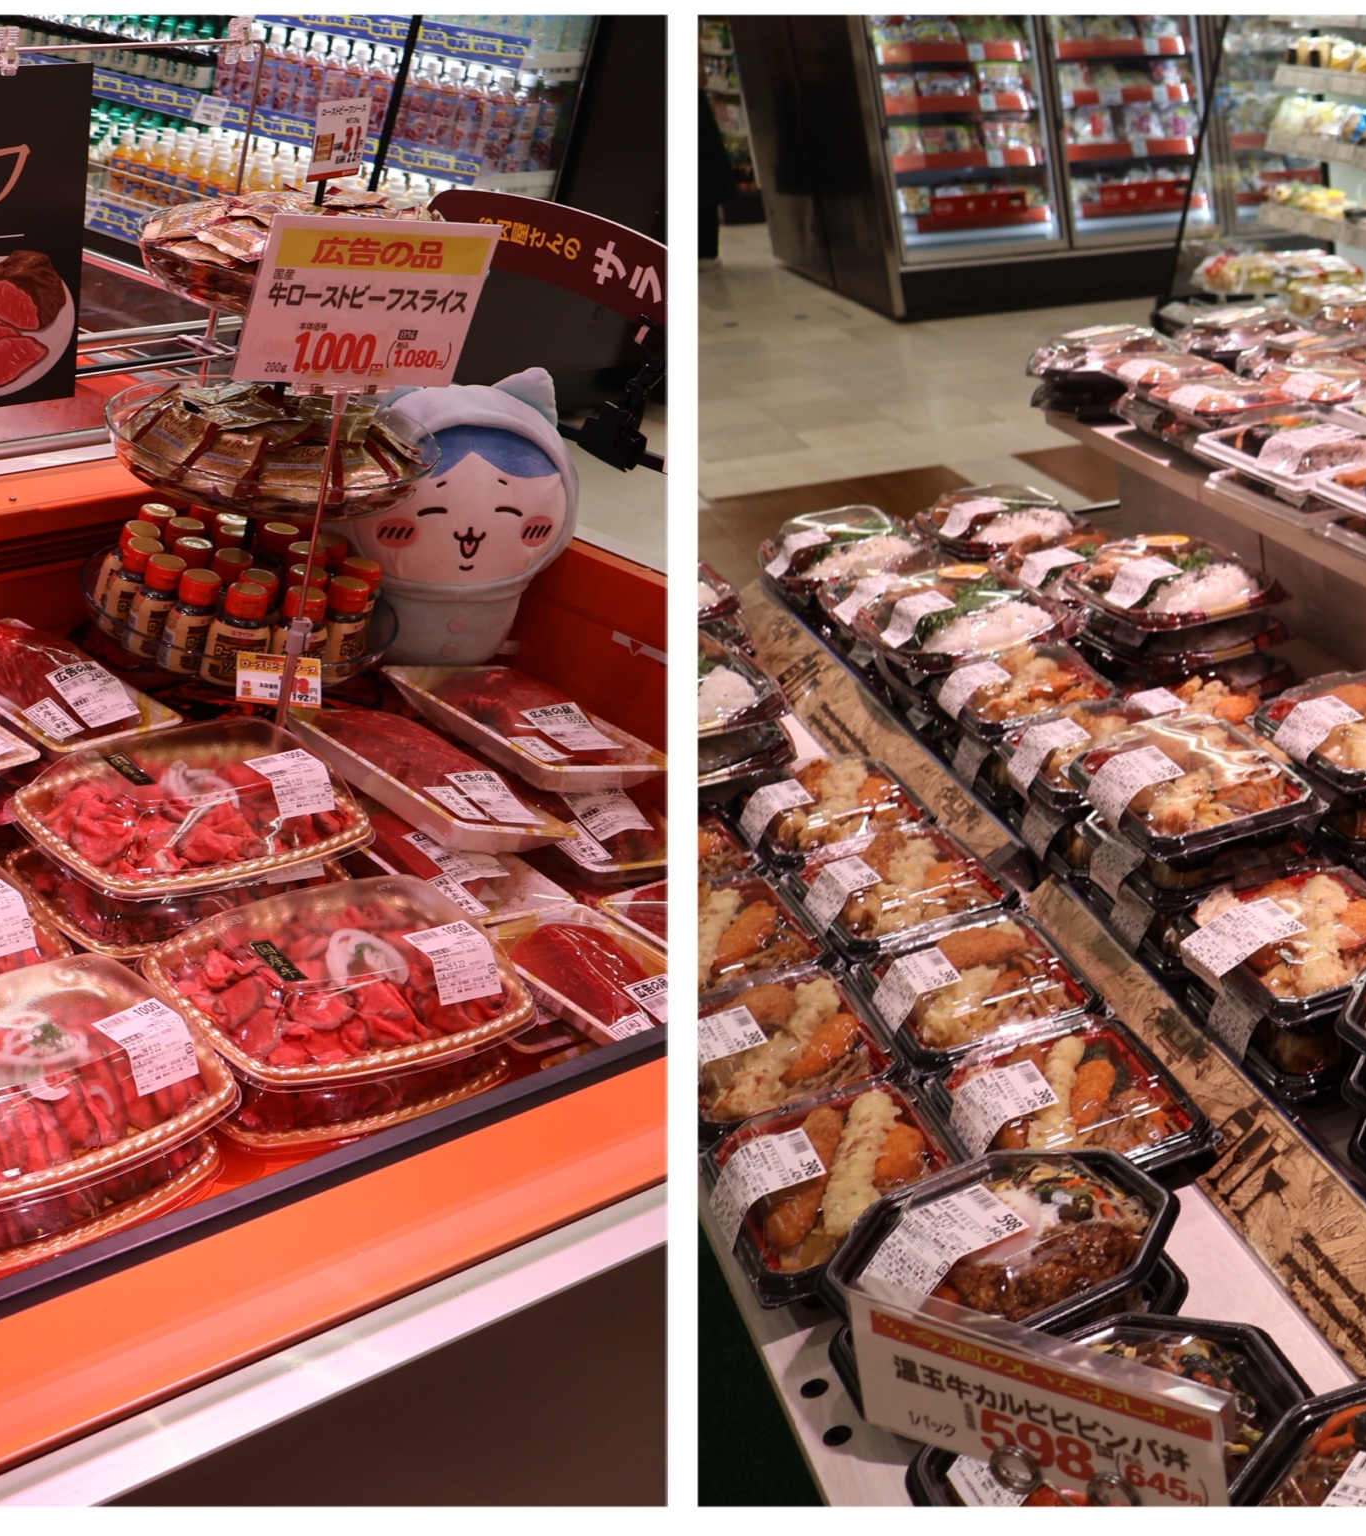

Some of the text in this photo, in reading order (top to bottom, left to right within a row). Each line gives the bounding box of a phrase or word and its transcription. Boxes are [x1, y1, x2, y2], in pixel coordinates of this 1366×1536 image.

[311, 237, 445, 270] 広告の品
[273, 268, 295, 281] 国産
[268, 282, 469, 315] 牛ローストビーフスライス
[264, 361, 288, 376] 200g
[54, 661, 98, 683] 広告の品
[894, 1354, 1191, 1473] 温玉牛カルビビビンバ丼
